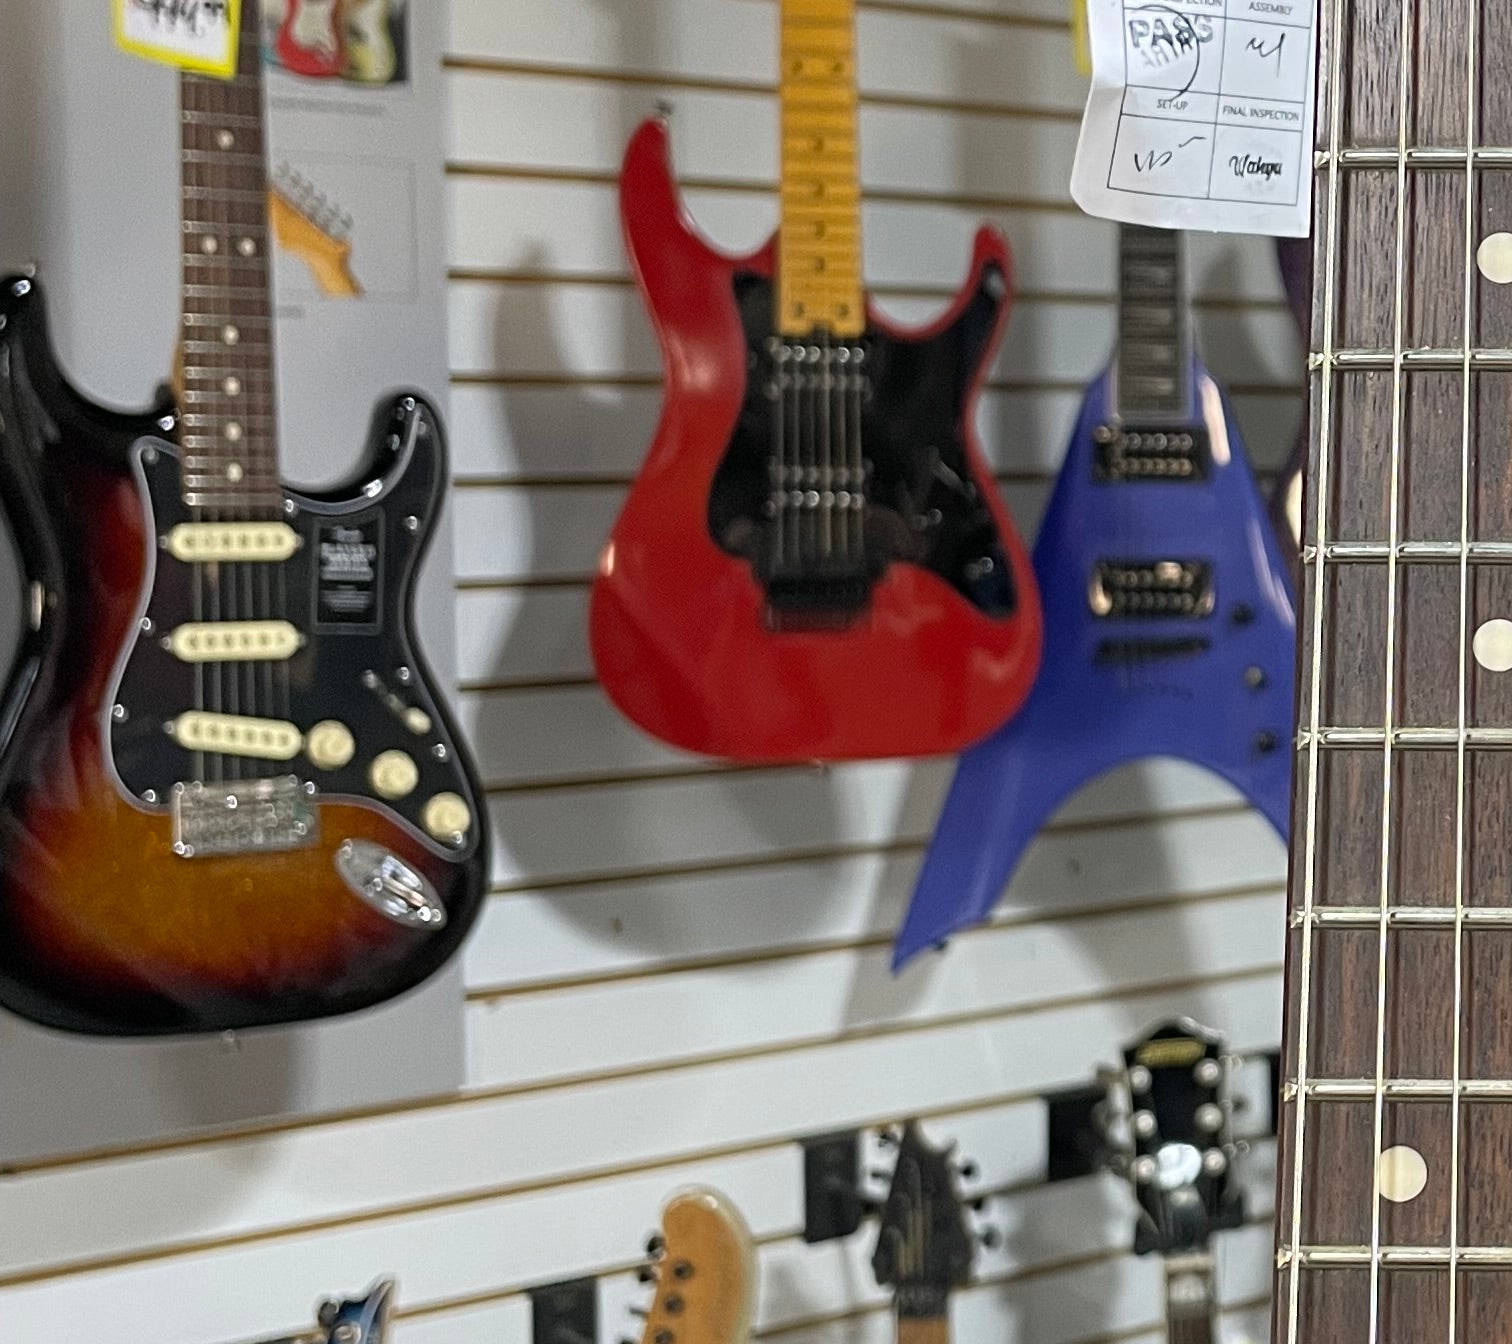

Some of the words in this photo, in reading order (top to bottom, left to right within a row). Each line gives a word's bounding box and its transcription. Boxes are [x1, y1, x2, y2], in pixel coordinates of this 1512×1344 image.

[1249, 1, 1293, 16] ASSEMBLY
[1223, 105, 1247, 117] FINAL
[1250, 107, 1299, 121] INSPECTION
